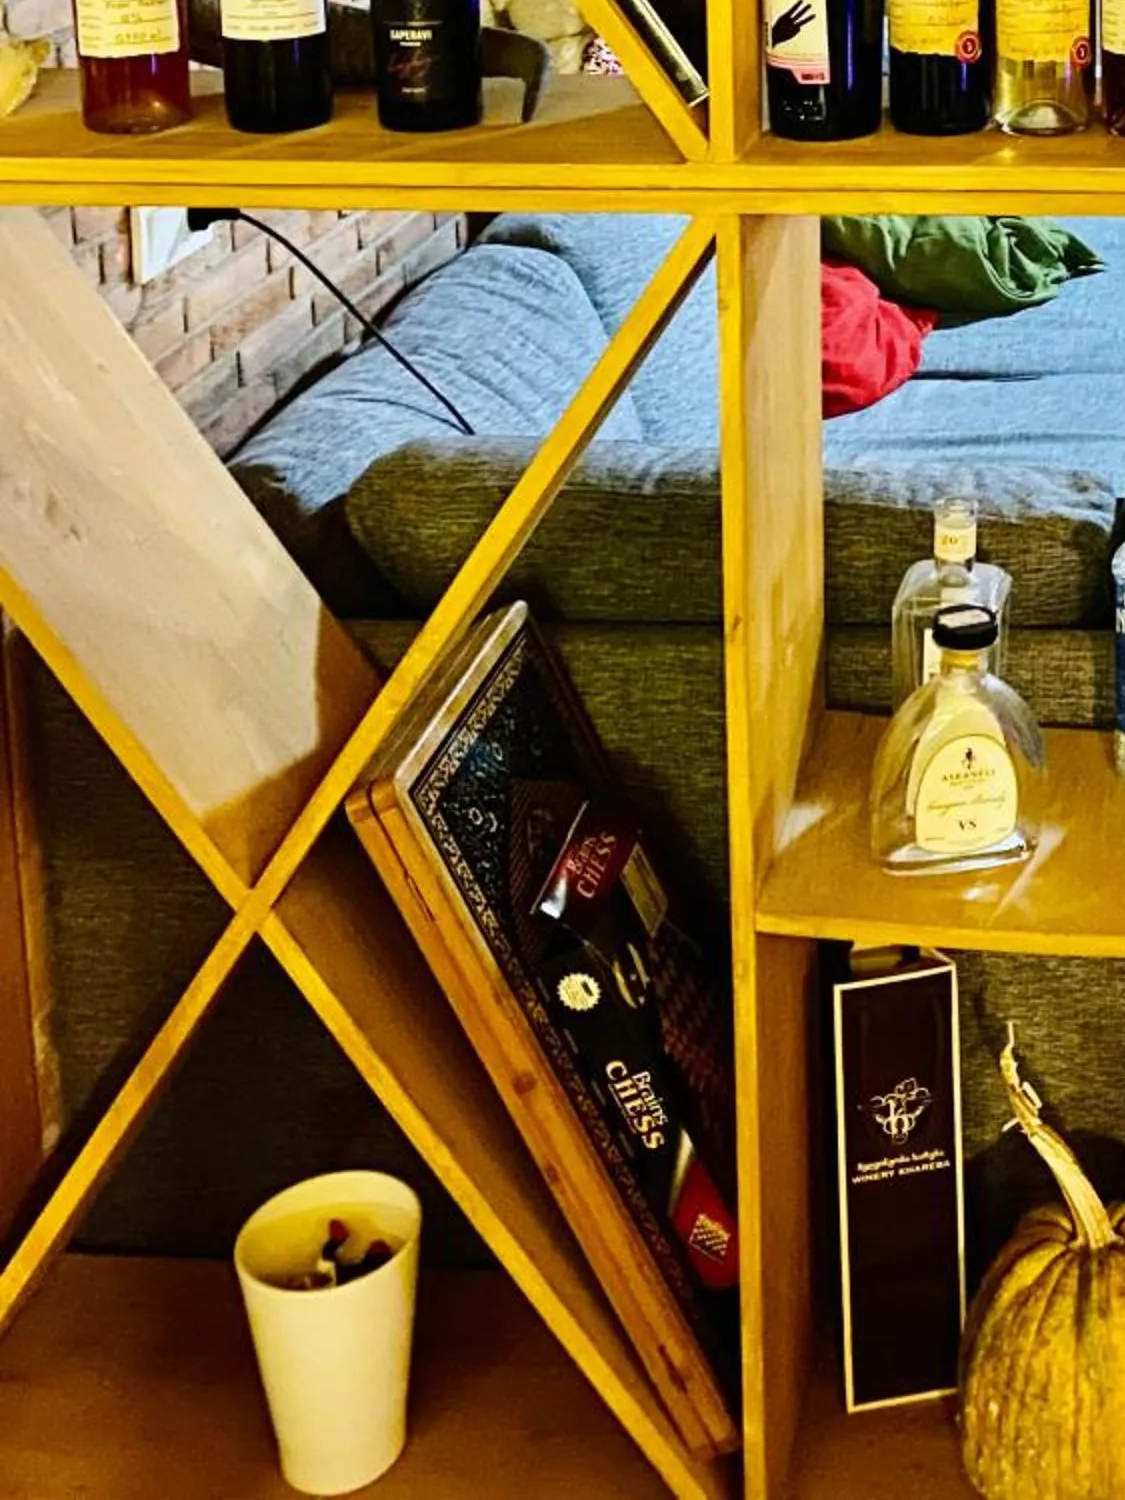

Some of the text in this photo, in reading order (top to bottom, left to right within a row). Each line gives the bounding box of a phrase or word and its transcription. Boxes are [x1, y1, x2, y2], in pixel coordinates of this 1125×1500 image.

[576, 831, 616, 898] CHESS
[605, 1060, 665, 1149] CHESS
[852, 1169, 895, 1184] WINERY
